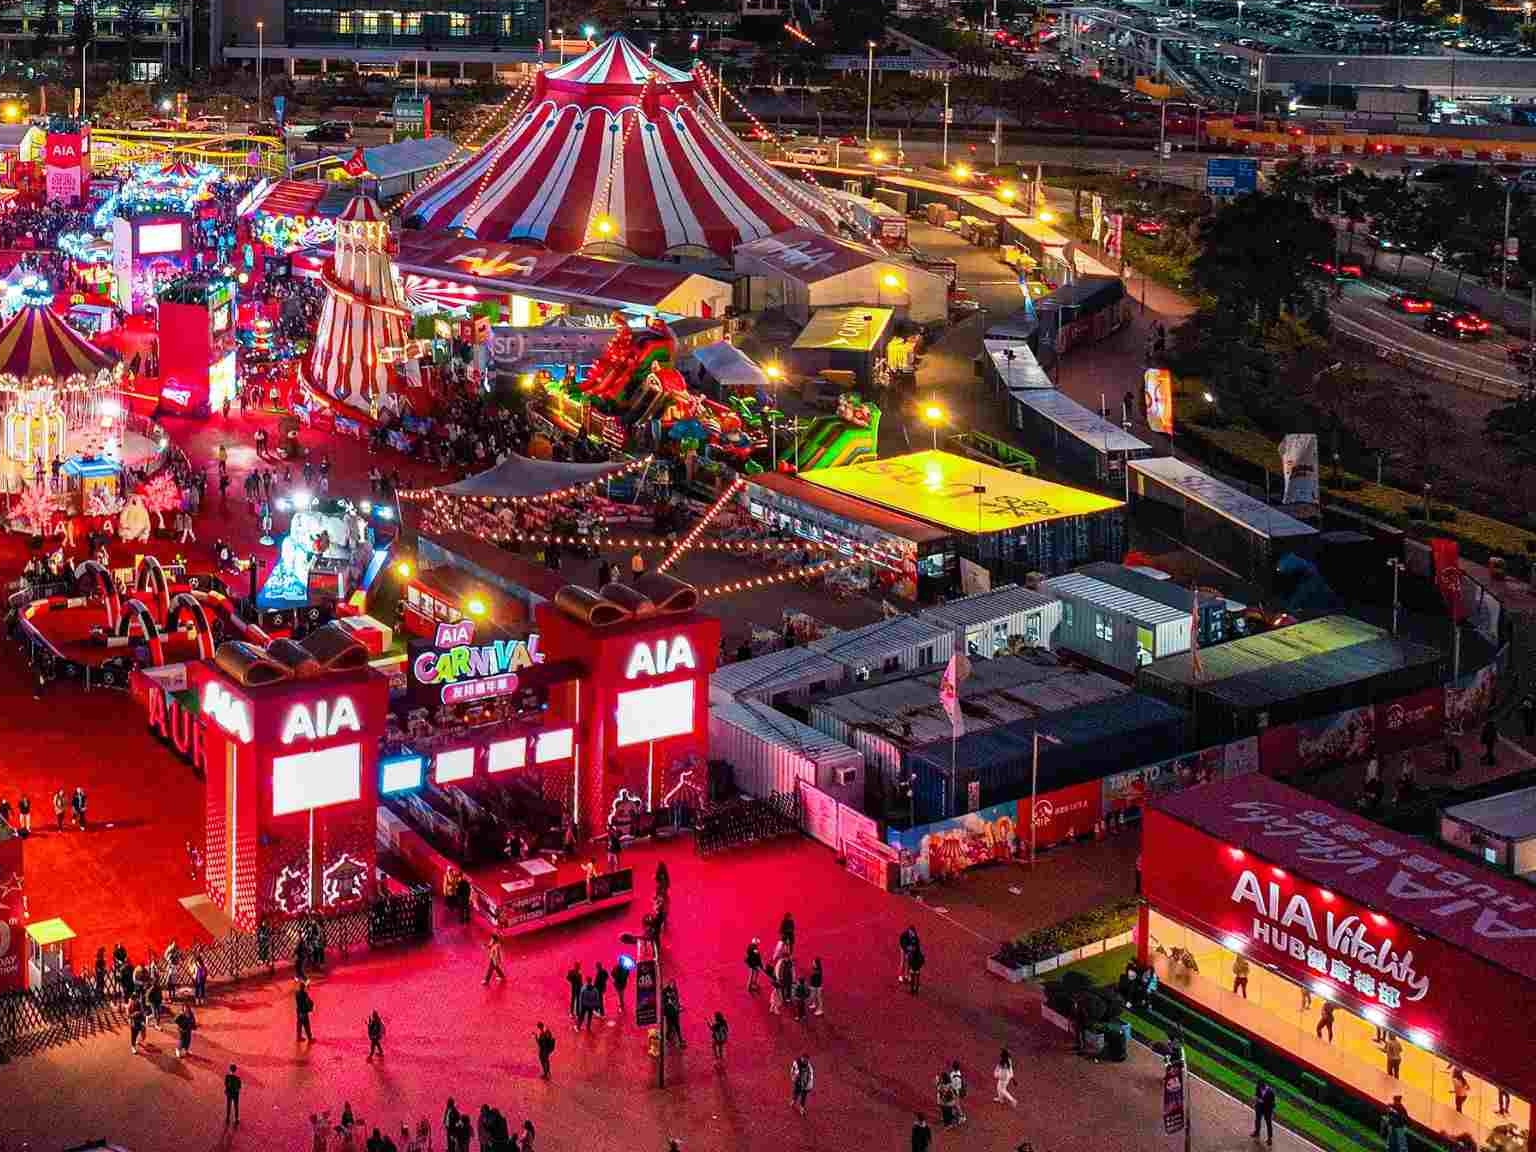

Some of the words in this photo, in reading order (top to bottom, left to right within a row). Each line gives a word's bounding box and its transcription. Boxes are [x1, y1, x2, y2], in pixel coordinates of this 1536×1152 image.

[396, 122, 421, 132] EXIT
[51, 144, 76, 157] AIA
[440, 626, 468, 645] AIA
[624, 635, 697, 680] AIA
[414, 633, 546, 685] CARNIVAL
[281, 695, 362, 745] AIA
[1230, 869, 1319, 942] AIA
[1325, 910, 1431, 1002] Vitality
